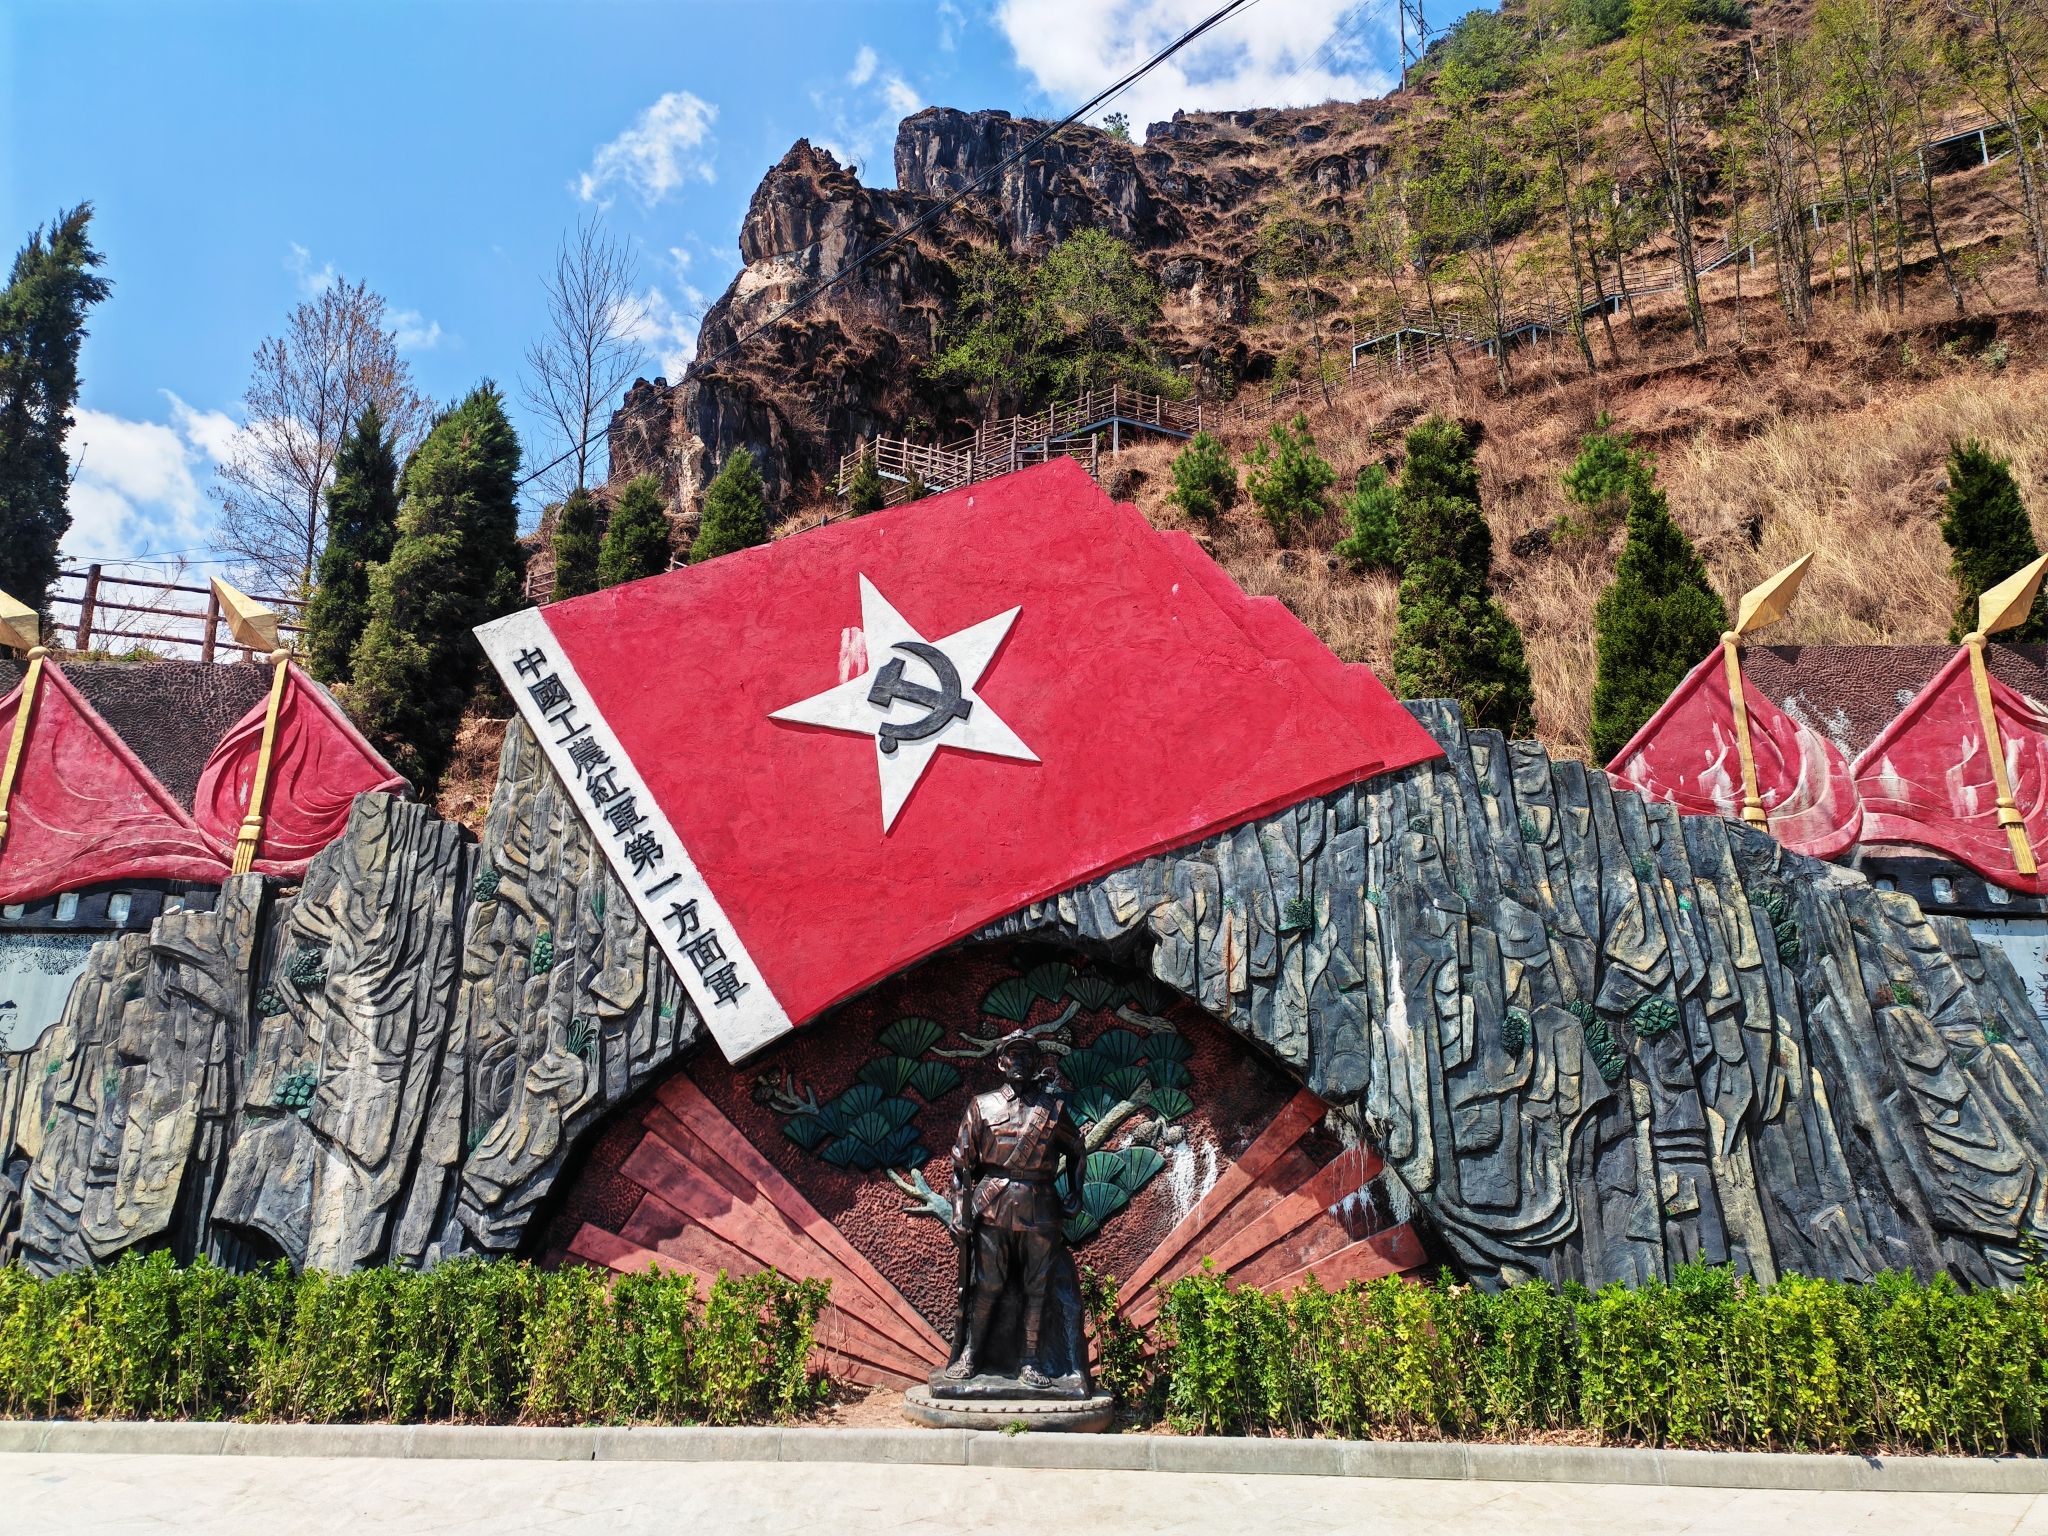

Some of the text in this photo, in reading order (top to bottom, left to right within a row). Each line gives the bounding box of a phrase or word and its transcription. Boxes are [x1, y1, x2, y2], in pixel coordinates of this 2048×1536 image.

[513, 647, 749, 1010] 中國工農紅軍第一方面軍
